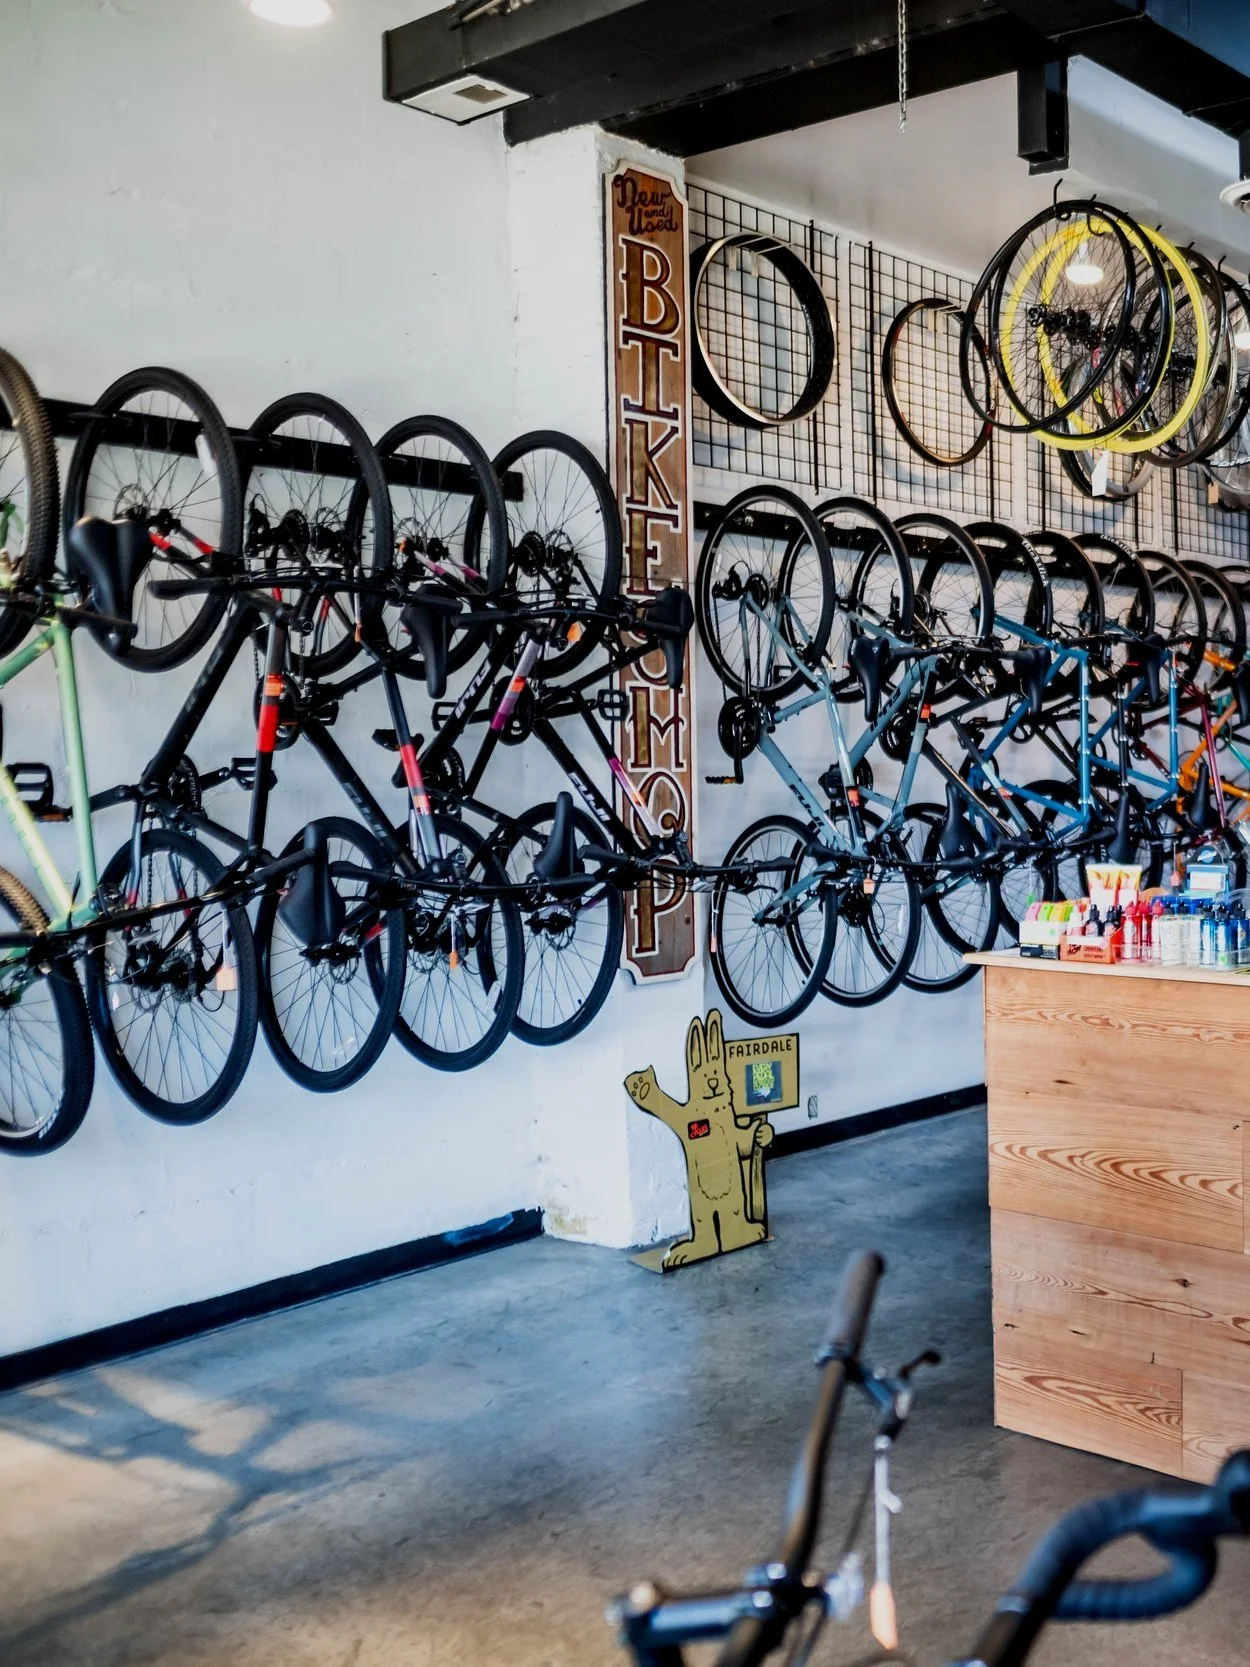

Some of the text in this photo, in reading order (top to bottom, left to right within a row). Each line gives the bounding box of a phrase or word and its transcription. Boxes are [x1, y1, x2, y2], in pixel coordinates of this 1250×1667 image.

[613, 174, 671, 208] New
[625, 204, 678, 236] Used
[644, 200, 669, 218] and
[454, 659, 492, 719] FUJI
[567, 771, 611, 822] FUJI
[788, 784, 825, 827] FUJI
[729, 1038, 793, 1059] FAIRDALE
